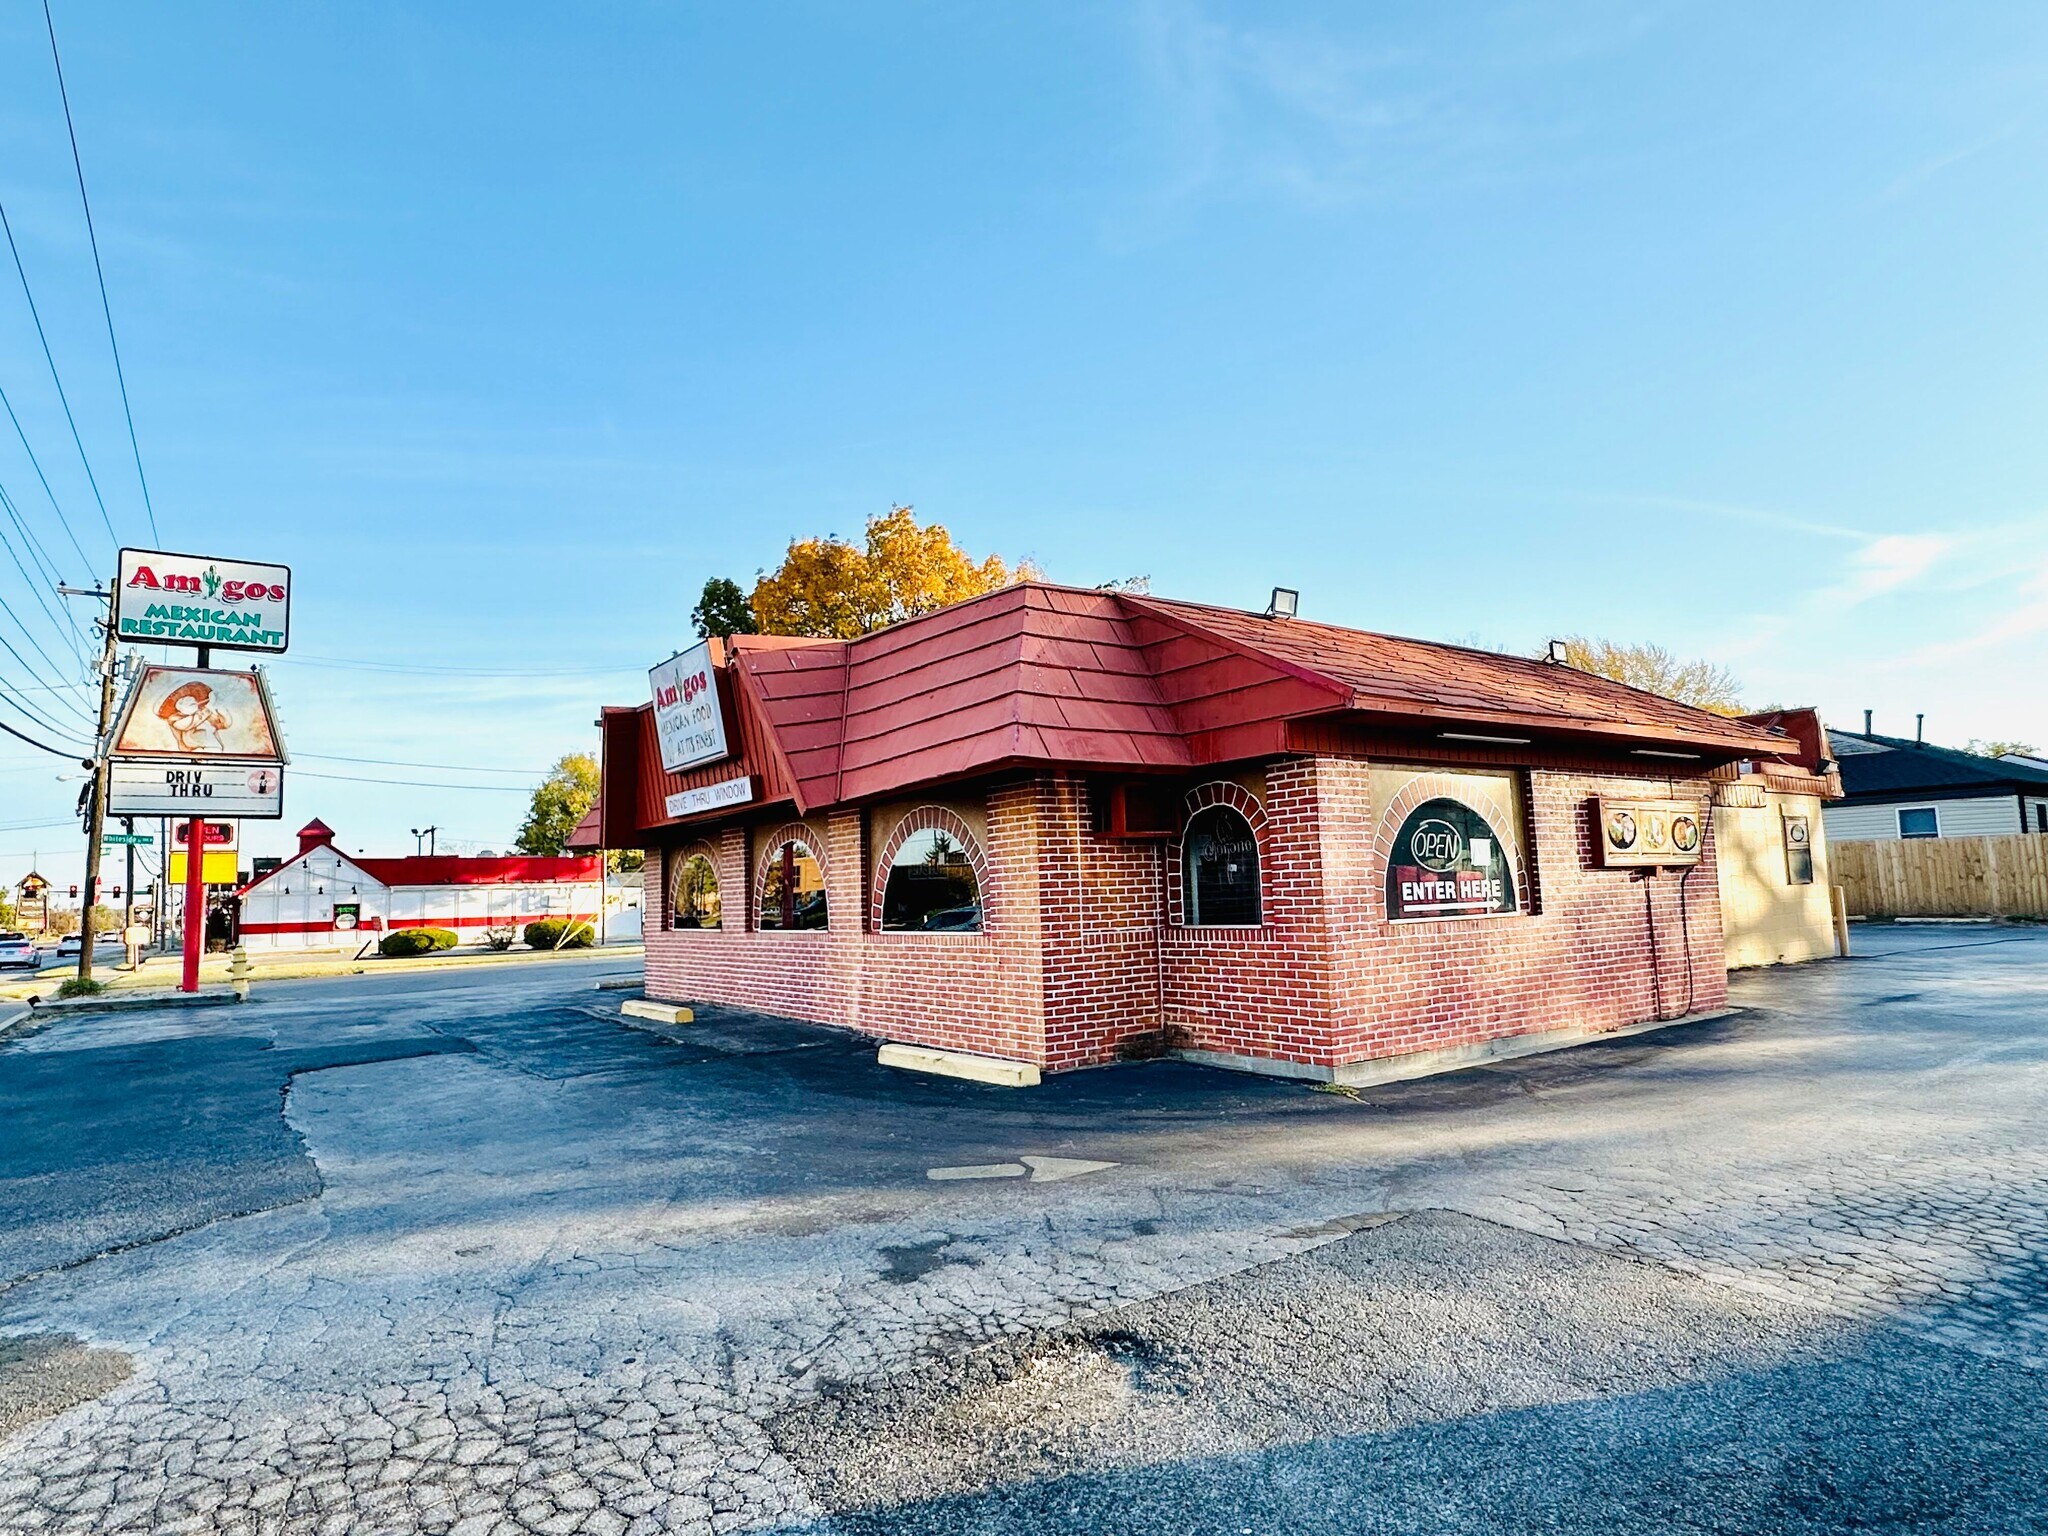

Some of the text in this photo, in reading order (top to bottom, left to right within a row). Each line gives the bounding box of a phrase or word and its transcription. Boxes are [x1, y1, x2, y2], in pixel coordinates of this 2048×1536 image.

[127, 565, 286, 604] Amigos
[144, 603, 262, 627] MEXICAN
[121, 617, 284, 645] RESTAURANT
[656, 670, 707, 712] Amigos
[661, 703, 712, 736] MEXICAN FOOD
[677, 739, 686, 756] AT
[166, 771, 202, 783] DRIV
[170, 784, 213, 797] THRU
[669, 782, 746, 813] DRIVE THRU WINDOW
[1414, 832, 1457, 860] OPEN
[1402, 879, 1501, 901] ENTER HERE
